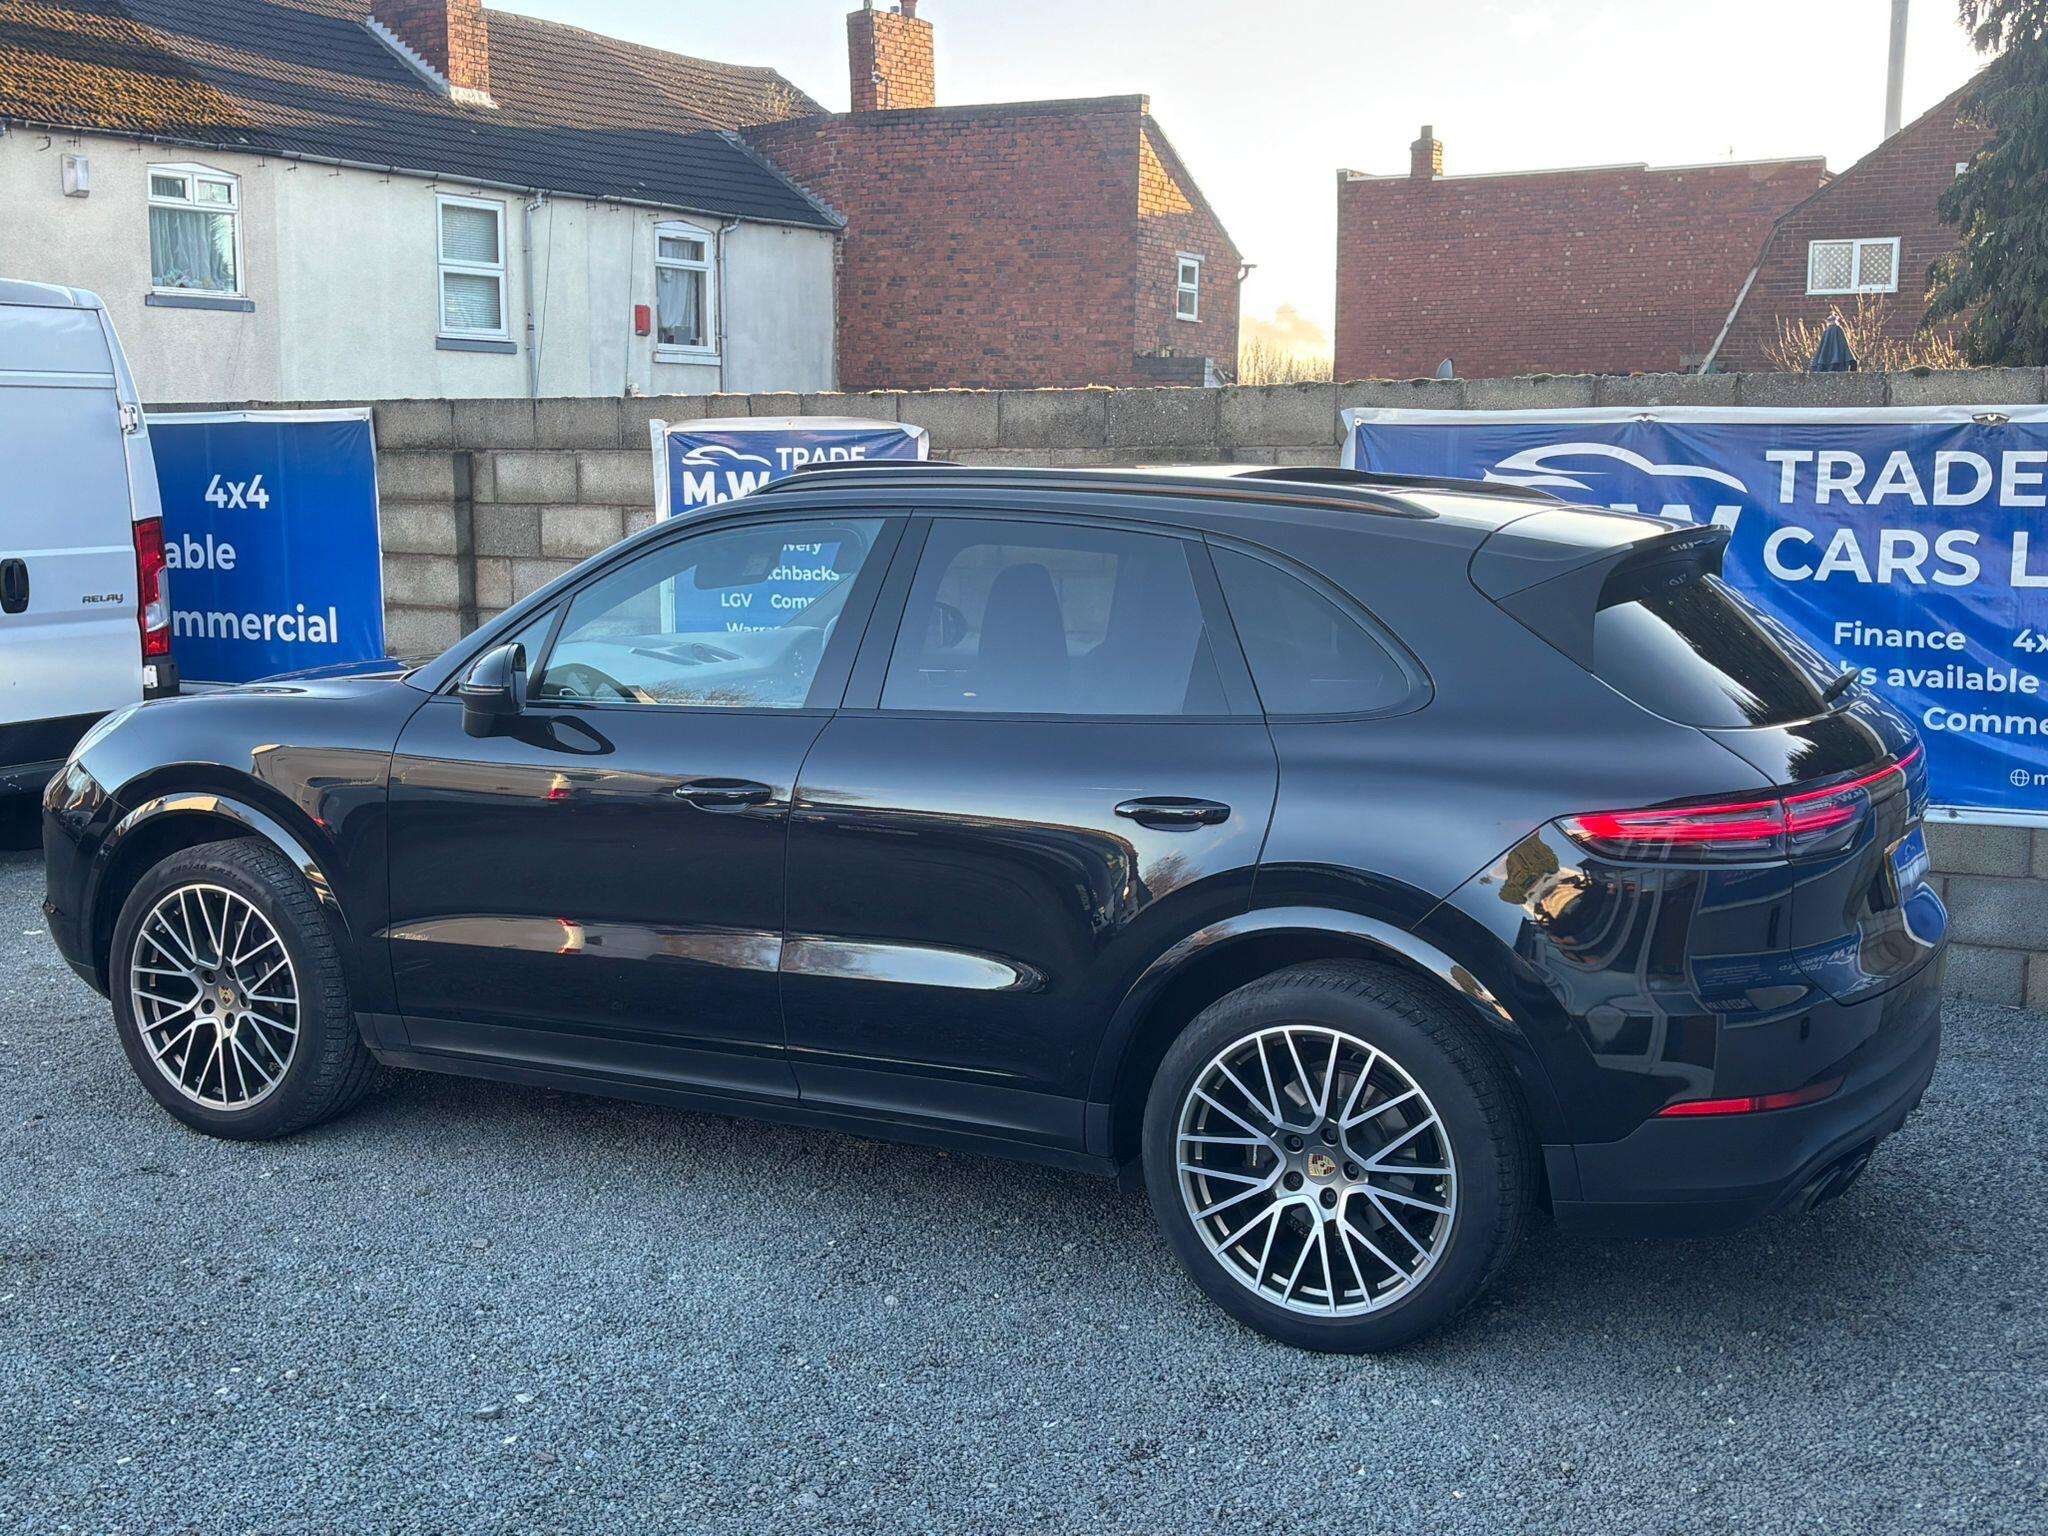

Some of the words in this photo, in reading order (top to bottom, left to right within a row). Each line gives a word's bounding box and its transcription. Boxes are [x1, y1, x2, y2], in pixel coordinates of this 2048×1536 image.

[205, 474, 270, 510] 4x4
[1766, 449, 2048, 507] TRADE
[165, 533, 236, 570] able
[1763, 526, 1981, 587] CARS
[82, 593, 124, 604] RELAY
[721, 593, 753, 608] LGV
[173, 603, 338, 644] mmercial
[1834, 620, 1967, 650] Finance
[1887, 663, 2040, 694] available
